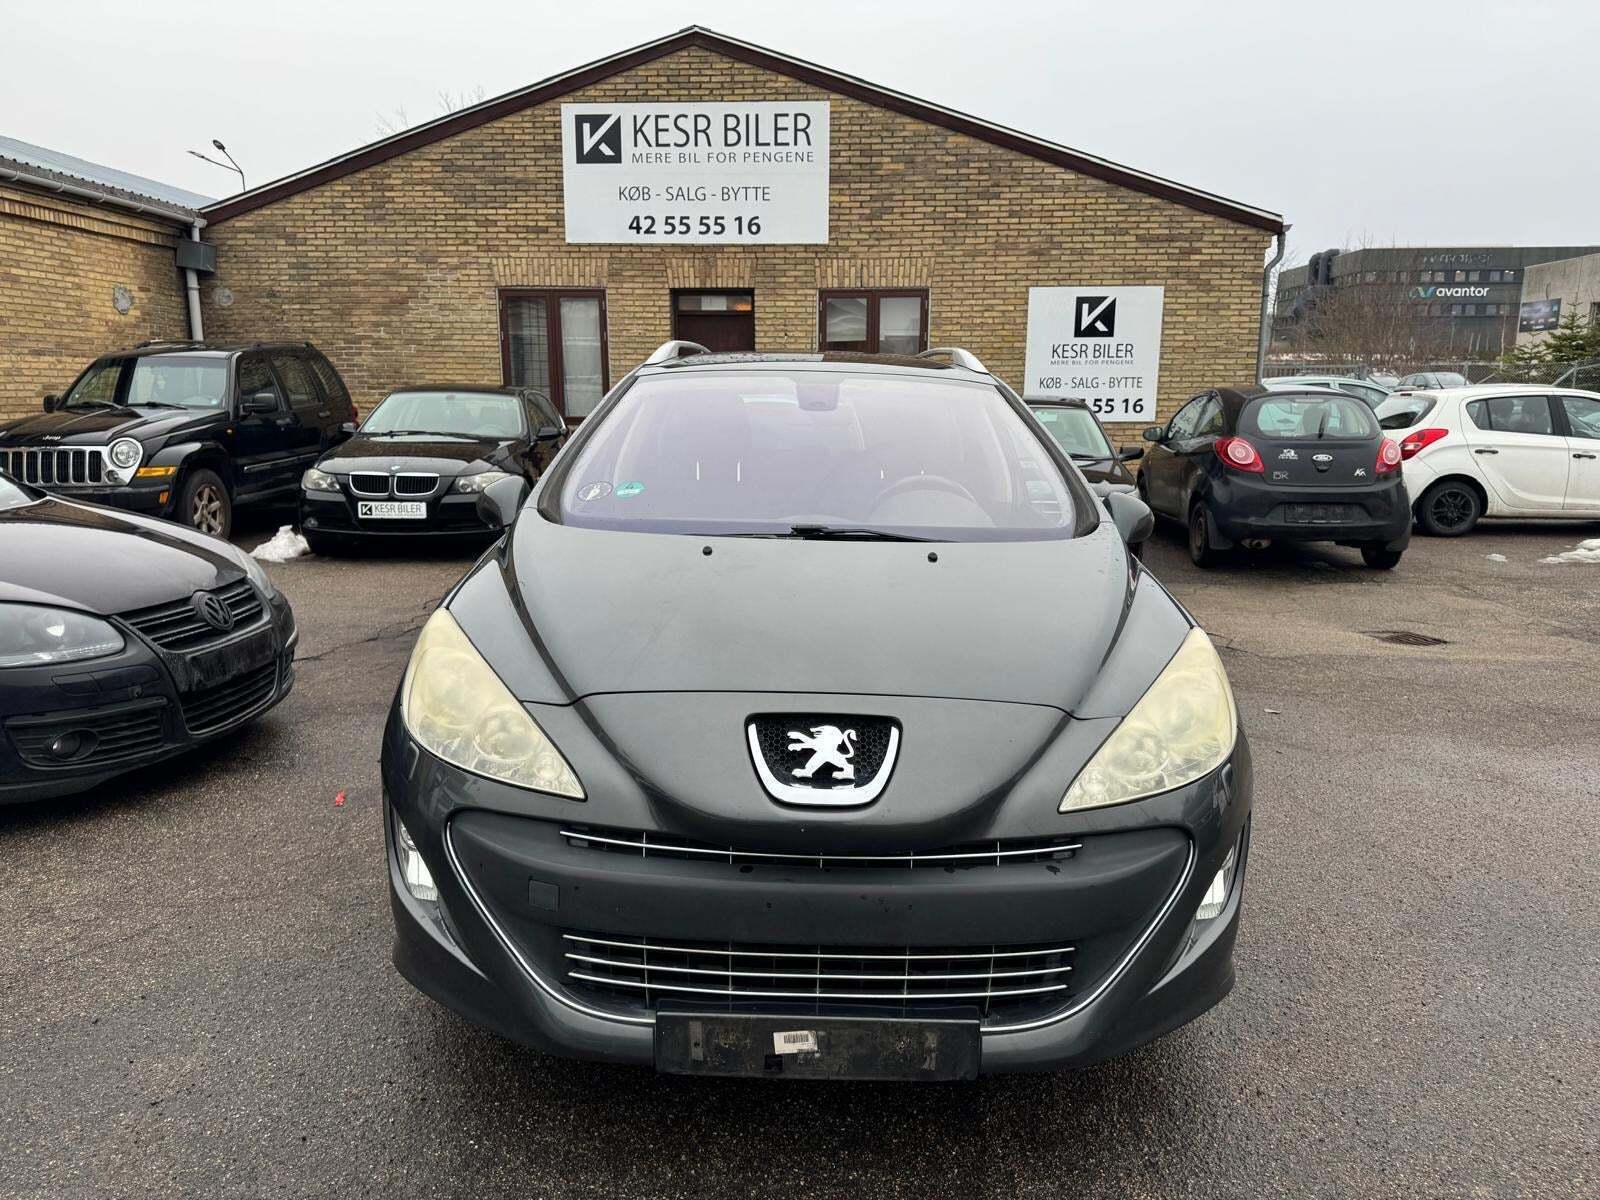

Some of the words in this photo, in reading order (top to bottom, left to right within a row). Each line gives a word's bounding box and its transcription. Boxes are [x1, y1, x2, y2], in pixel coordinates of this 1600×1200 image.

[632, 113, 712, 148] KESR
[723, 112, 813, 147] BILER
[631, 152, 673, 164] MERE
[678, 152, 701, 164] BIL
[707, 152, 737, 163] FOR
[743, 151, 815, 163] PENGENE
[618, 186, 652, 202] KØB
[665, 186, 707, 202] SALG
[721, 186, 771, 202] BYTTE
[628, 216, 657, 235] 42
[663, 216, 692, 235] 55
[698, 216, 726, 235] 55
[734, 216, 762, 235] 16
[1436, 286, 1490, 297] avantor
[1052, 344, 1089, 359] KESR
[1092, 343, 1134, 359] BILER
[1039, 377, 1062, 389] KØB
[1071, 377, 1099, 388] SALG
[1108, 376, 1143, 388] BYTTE
[1092, 398, 1115, 414] 55
[1122, 398, 1144, 414] 16
[374, 503, 396, 513] KESR
[397, 504, 421, 513] BILER
